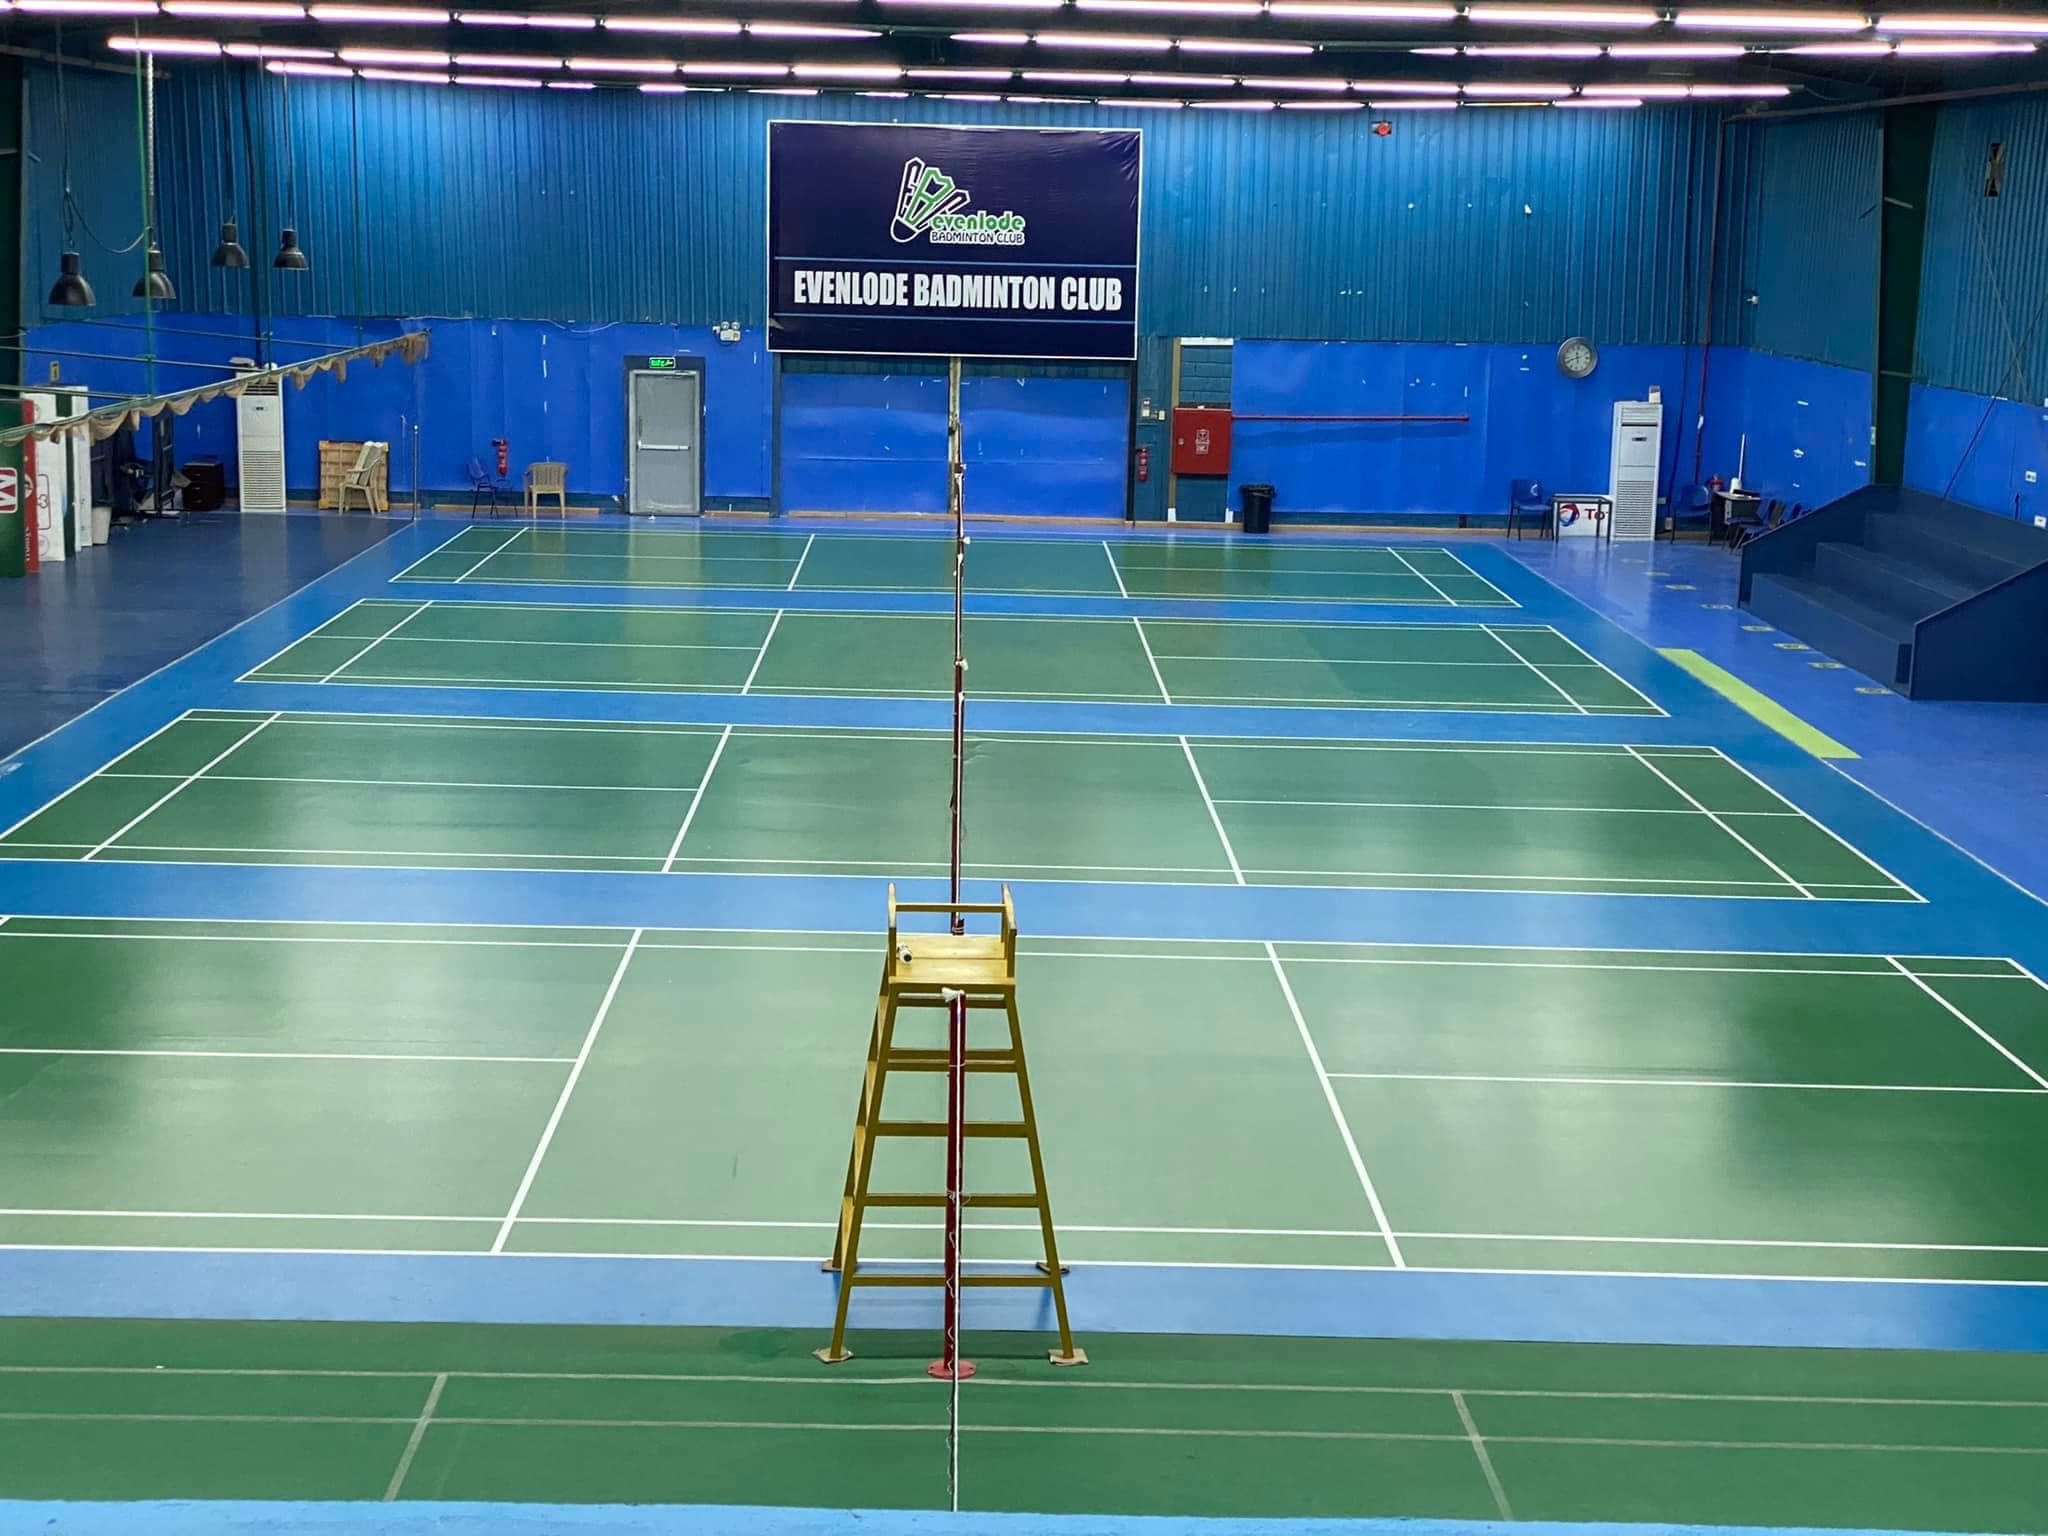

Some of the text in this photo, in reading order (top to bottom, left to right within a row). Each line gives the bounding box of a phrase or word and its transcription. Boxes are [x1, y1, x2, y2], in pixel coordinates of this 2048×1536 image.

[931, 211, 1025, 231] evenlode
[931, 231, 1024, 244] BADMINTON CLUB
[794, 270, 1122, 311] EVENLODE BADMINTON CLUB
